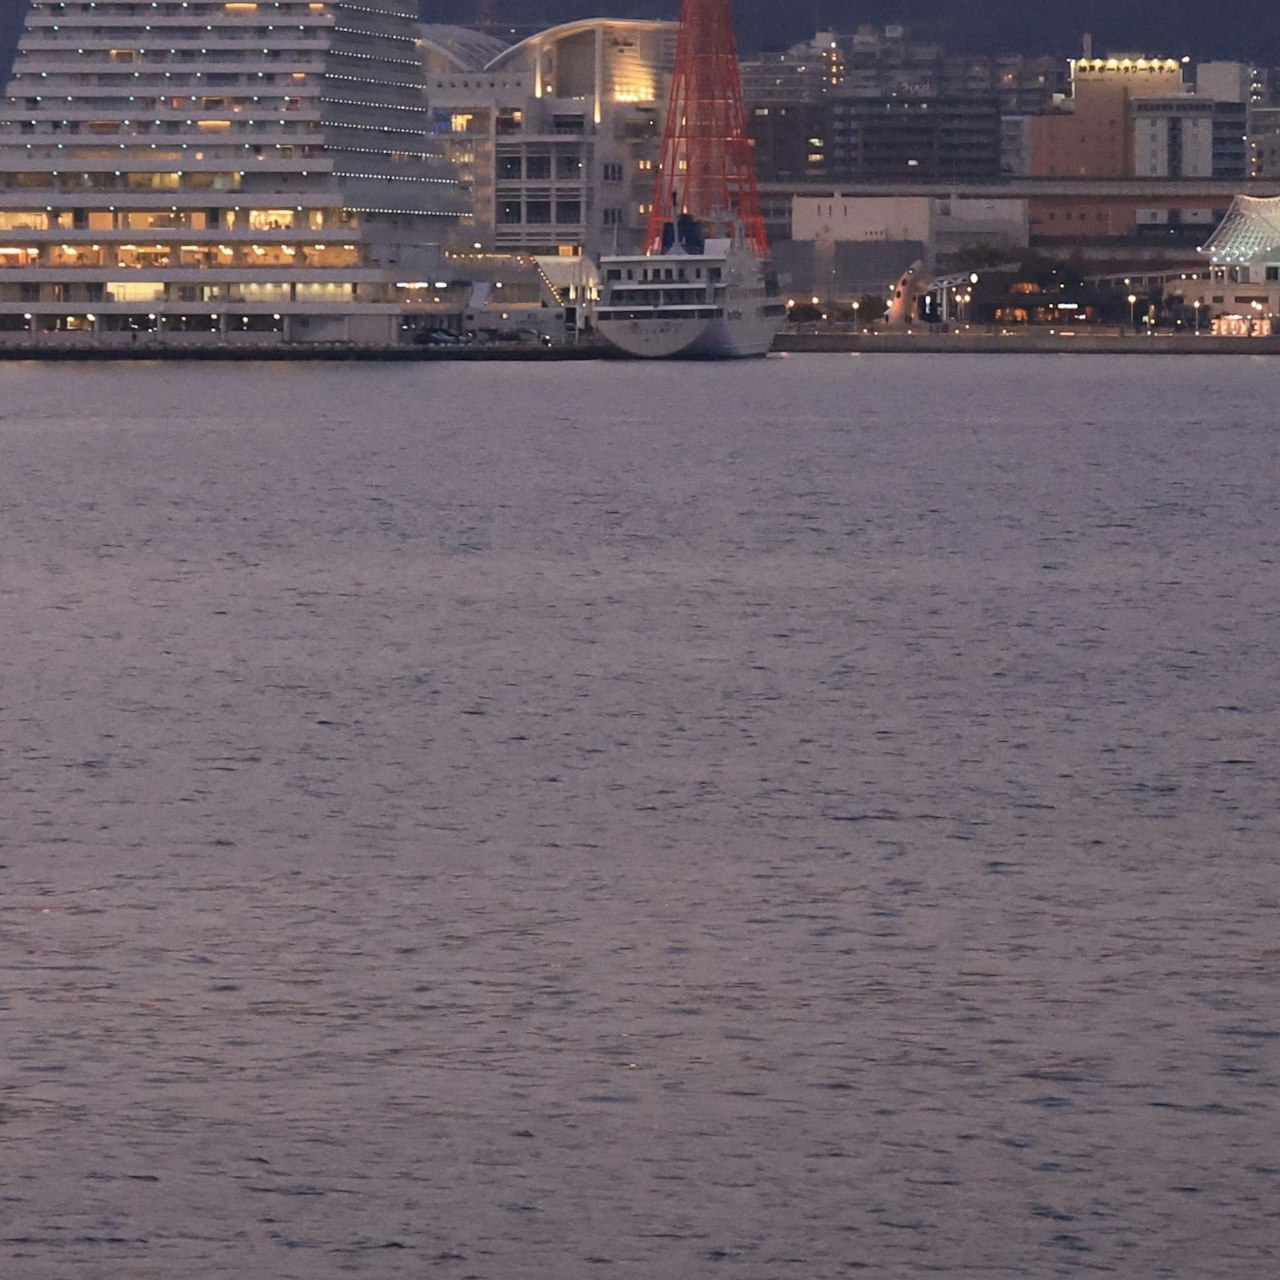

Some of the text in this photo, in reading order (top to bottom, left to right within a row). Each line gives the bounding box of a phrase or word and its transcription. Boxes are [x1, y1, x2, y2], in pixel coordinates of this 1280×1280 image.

[1078, 65, 1176, 74] 神戸ポートタワーホテル
